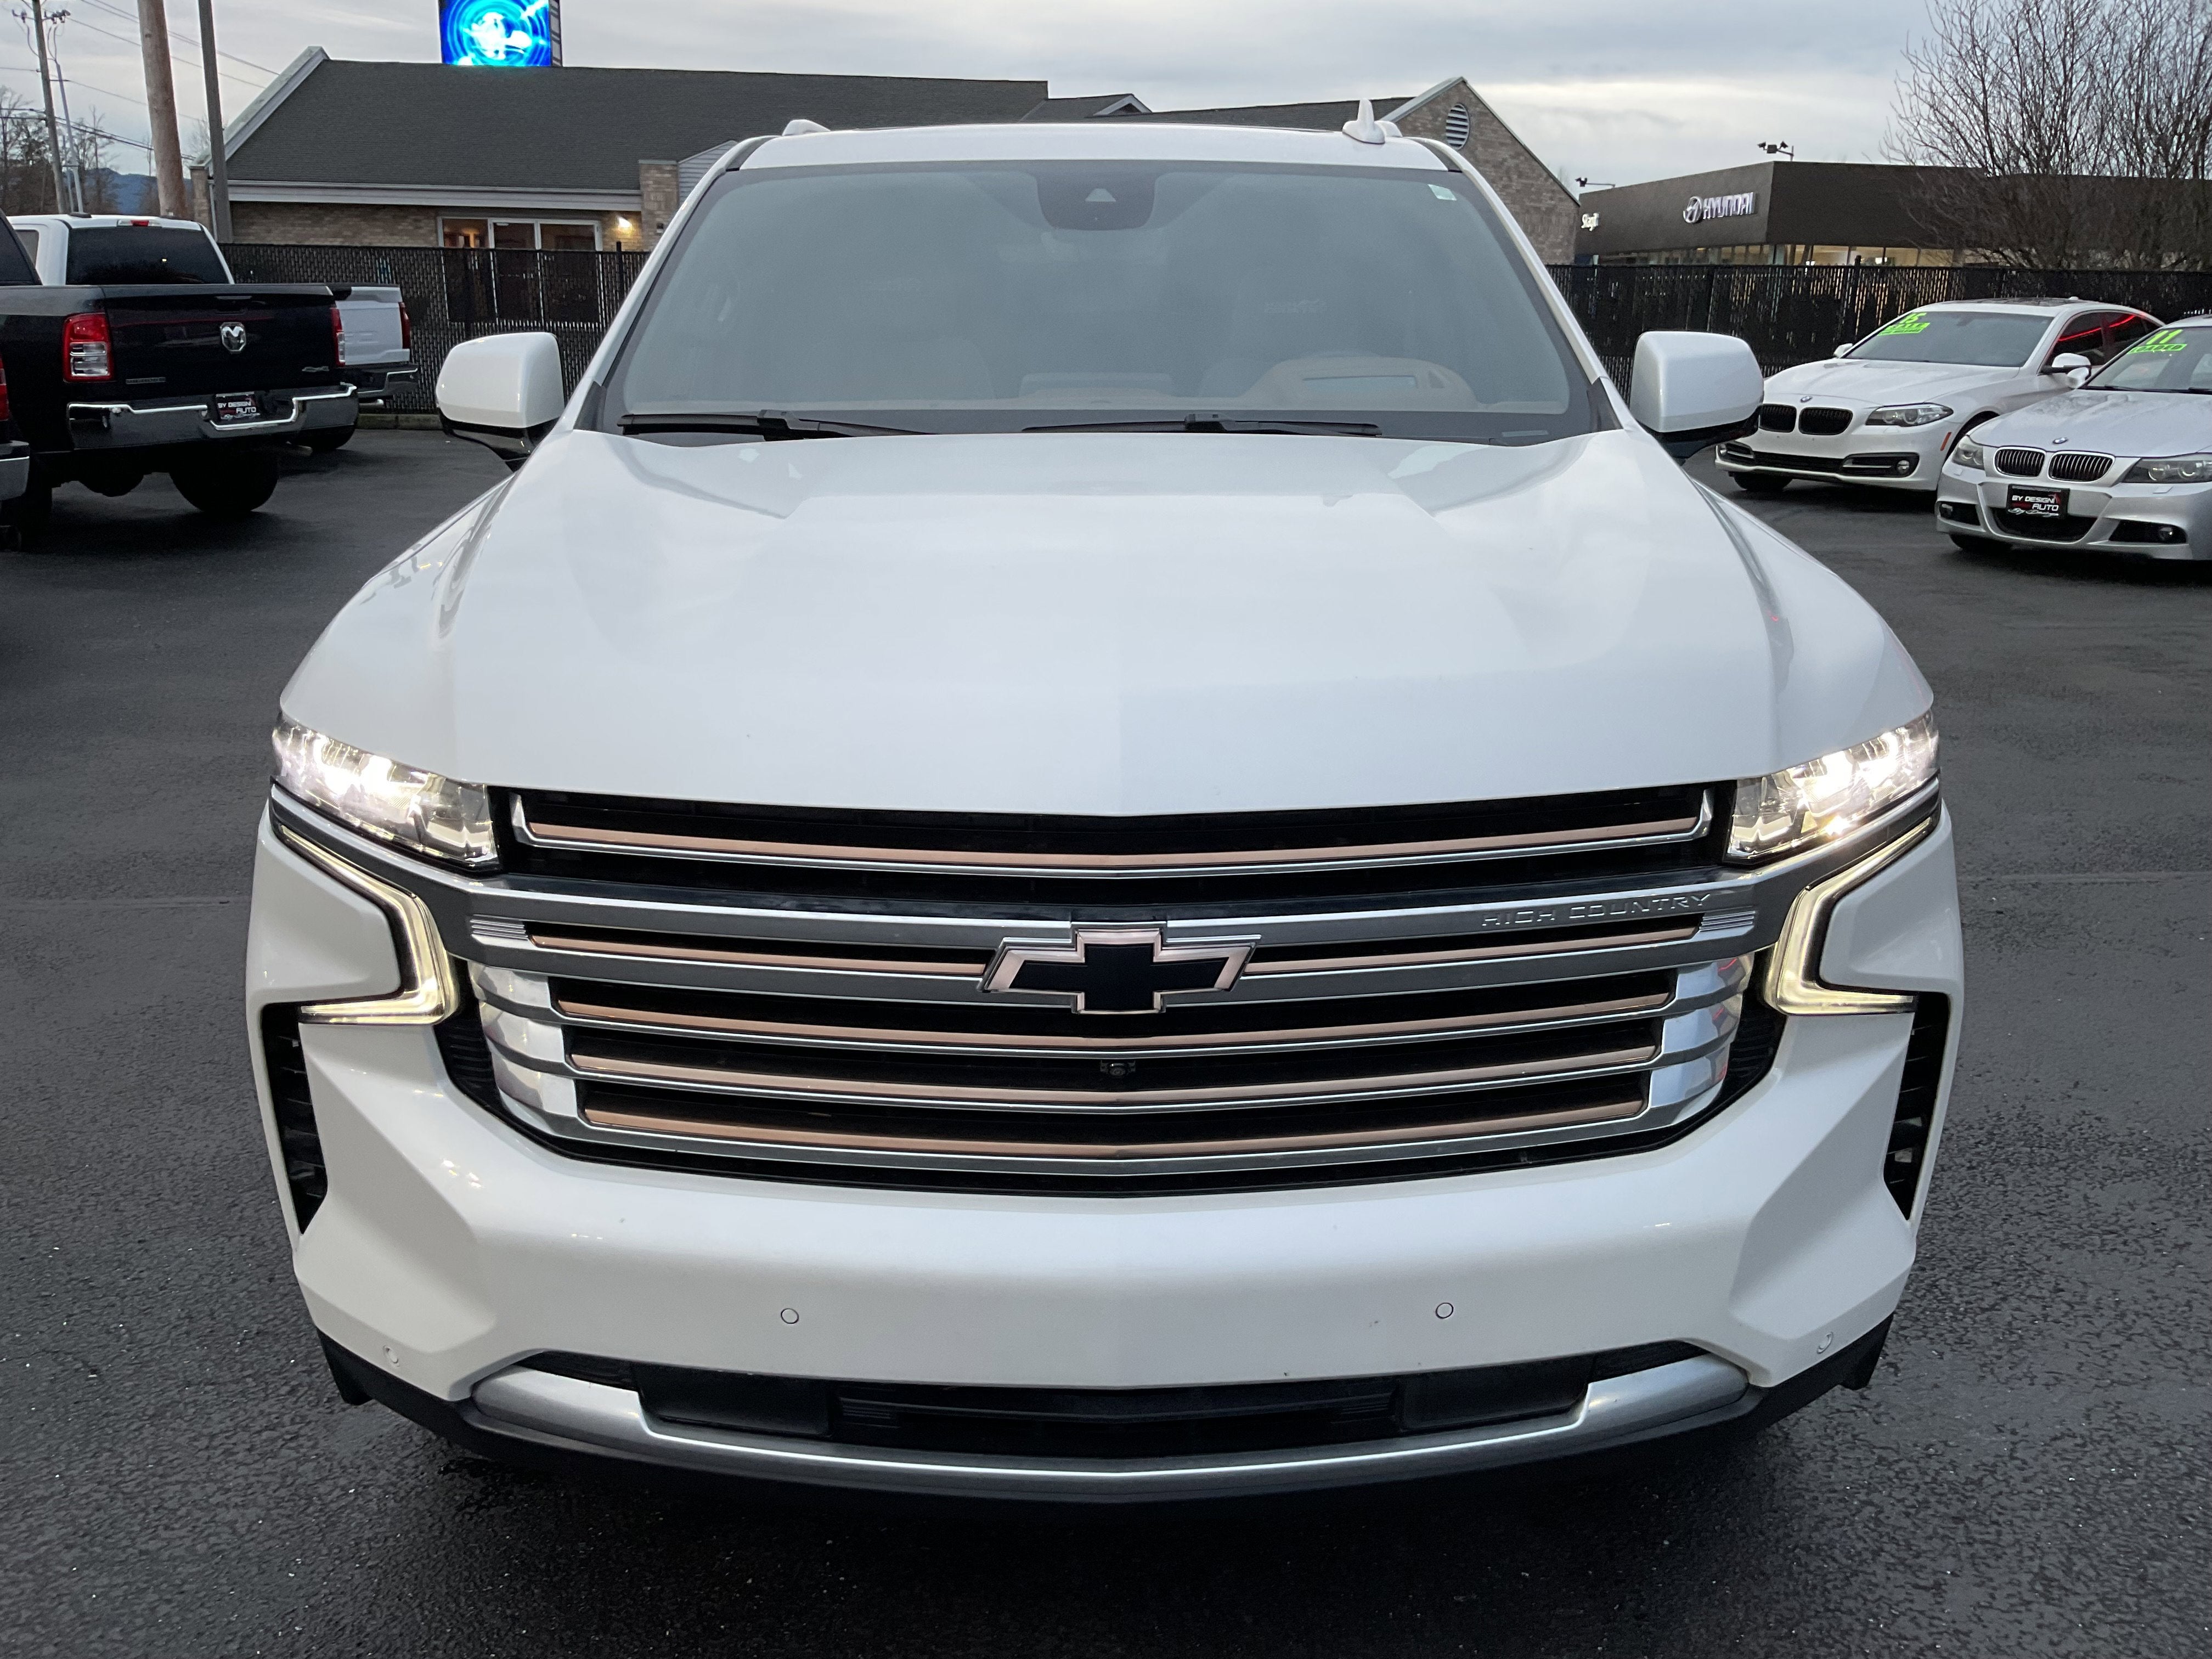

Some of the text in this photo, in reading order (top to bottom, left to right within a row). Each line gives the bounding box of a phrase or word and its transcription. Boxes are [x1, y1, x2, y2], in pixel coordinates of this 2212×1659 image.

[1702, 191, 1754, 219] HYUNDAI
[1899, 312, 1927, 324] 15
[2146, 329, 2183, 345] 11
[2032, 503, 2059, 511] AUTO
[1482, 893, 1711, 926] HIGH COUNTRY
